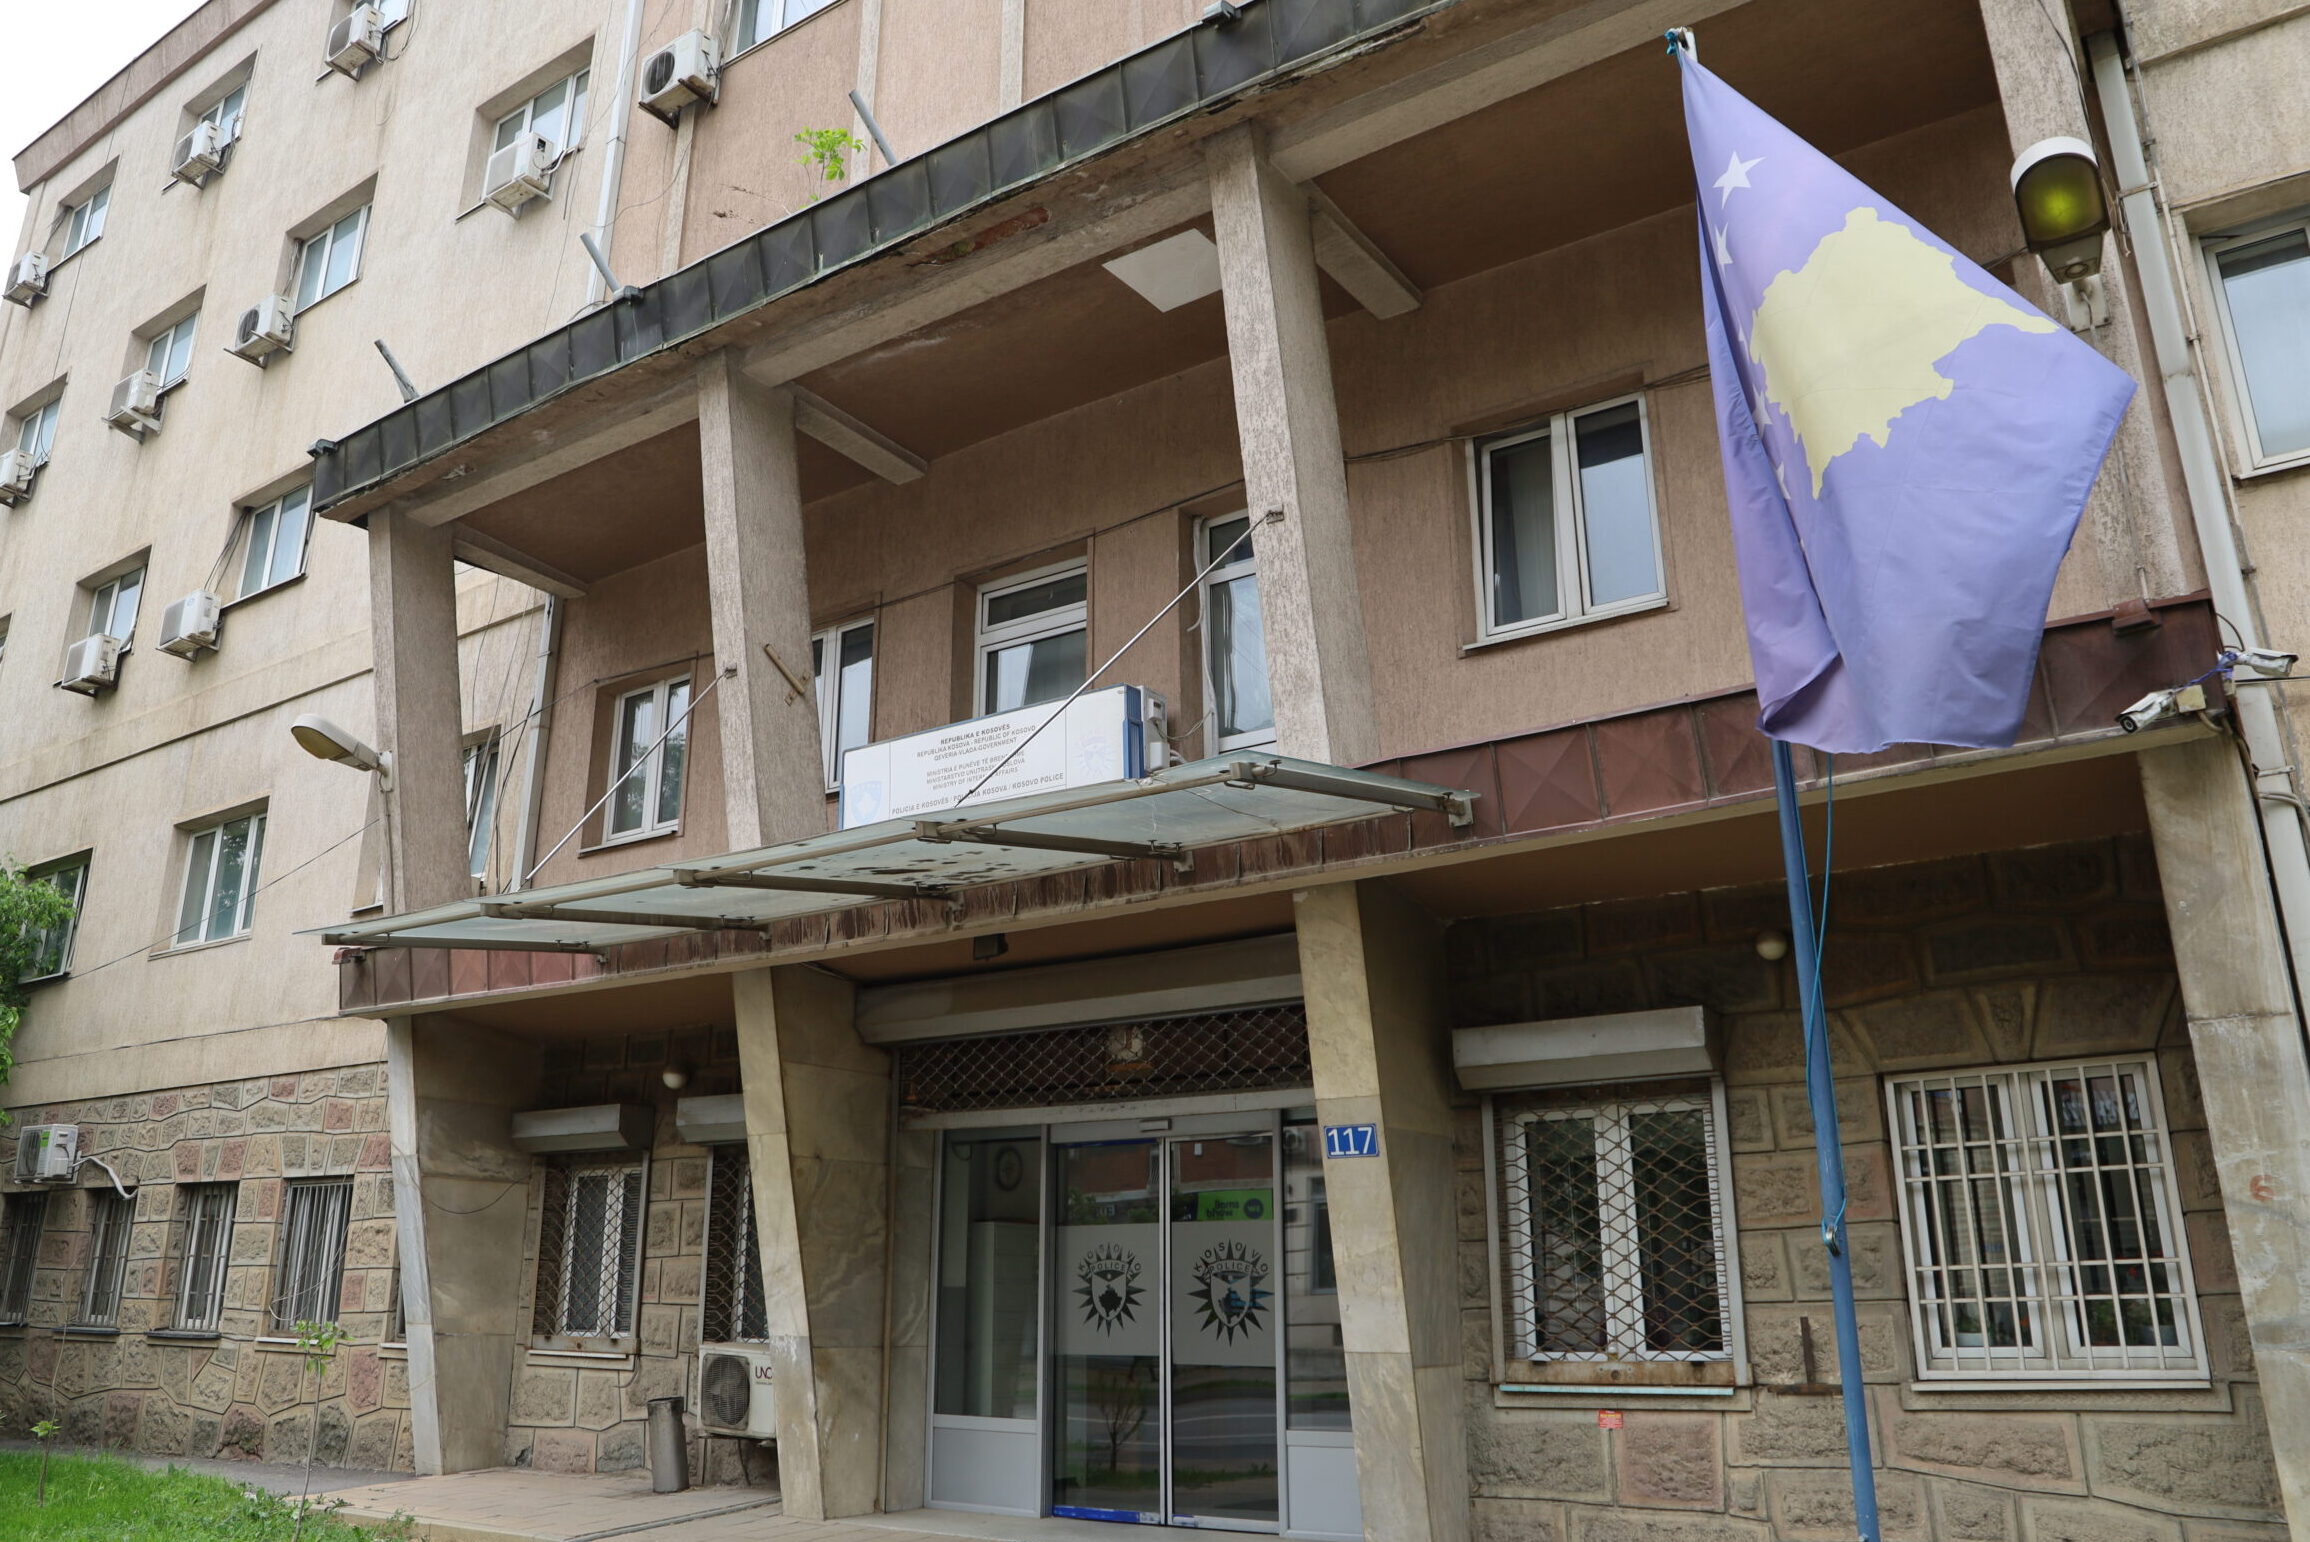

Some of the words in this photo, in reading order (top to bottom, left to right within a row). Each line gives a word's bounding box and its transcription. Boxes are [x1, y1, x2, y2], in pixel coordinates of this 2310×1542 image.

[917, 745, 946, 757] REPUBLIKA
[948, 740, 970, 750] KOSOVA
[974, 733, 1001, 744] REPUBLIC
[1011, 725, 1036, 736] KOSOVO
[940, 732, 974, 745] REPUBLIKA
[981, 724, 1010, 735] KOSOVËS
[926, 770, 965, 784] MINISTARSTVO
[927, 764, 952, 777] MINISTRIA
[932, 779, 957, 790] MINISTRY
[995, 766, 1018, 778] AFFAIRS
[892, 802, 916, 814] POLICIA
[982, 784, 1007, 796] KOSOVA
[1012, 778, 1038, 790] KOSOVO
[1040, 772, 1064, 784] POLICE
[1328, 1126, 1372, 1155] 117
[1090, 1261, 1126, 1272] POLICE
[1193, 1242, 1268, 1272] KOSOVO
[1208, 1261, 1250, 1273] POLICE
